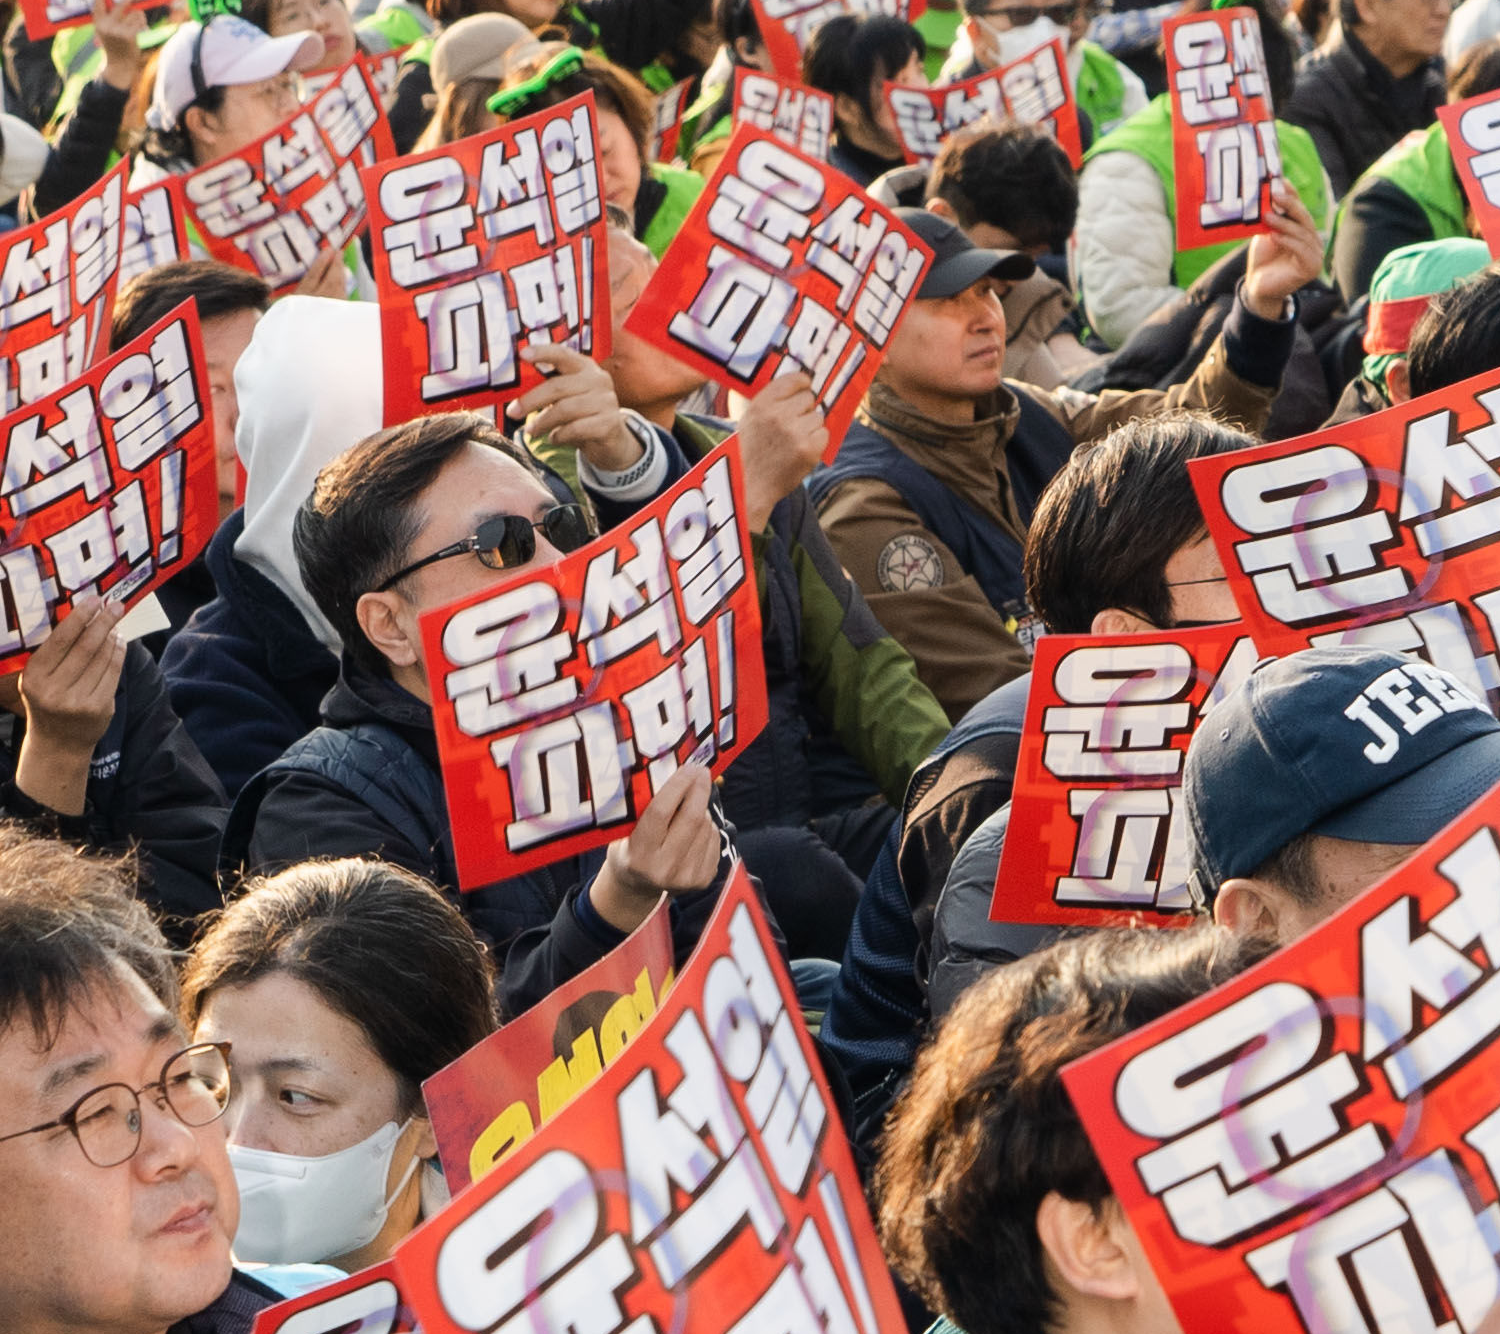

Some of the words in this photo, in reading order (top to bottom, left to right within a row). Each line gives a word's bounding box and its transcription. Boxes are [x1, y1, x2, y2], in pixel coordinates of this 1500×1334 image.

[202, 65, 380, 237] 윤석열
[378, 110, 603, 290] 윤석열
[412, 233, 596, 403] 파면!
[705, 138, 926, 353] 윤석열
[441, 455, 749, 736] 윤석열
[490, 611, 738, 853] 파면!
[1344, 663, 1494, 765] JEE
